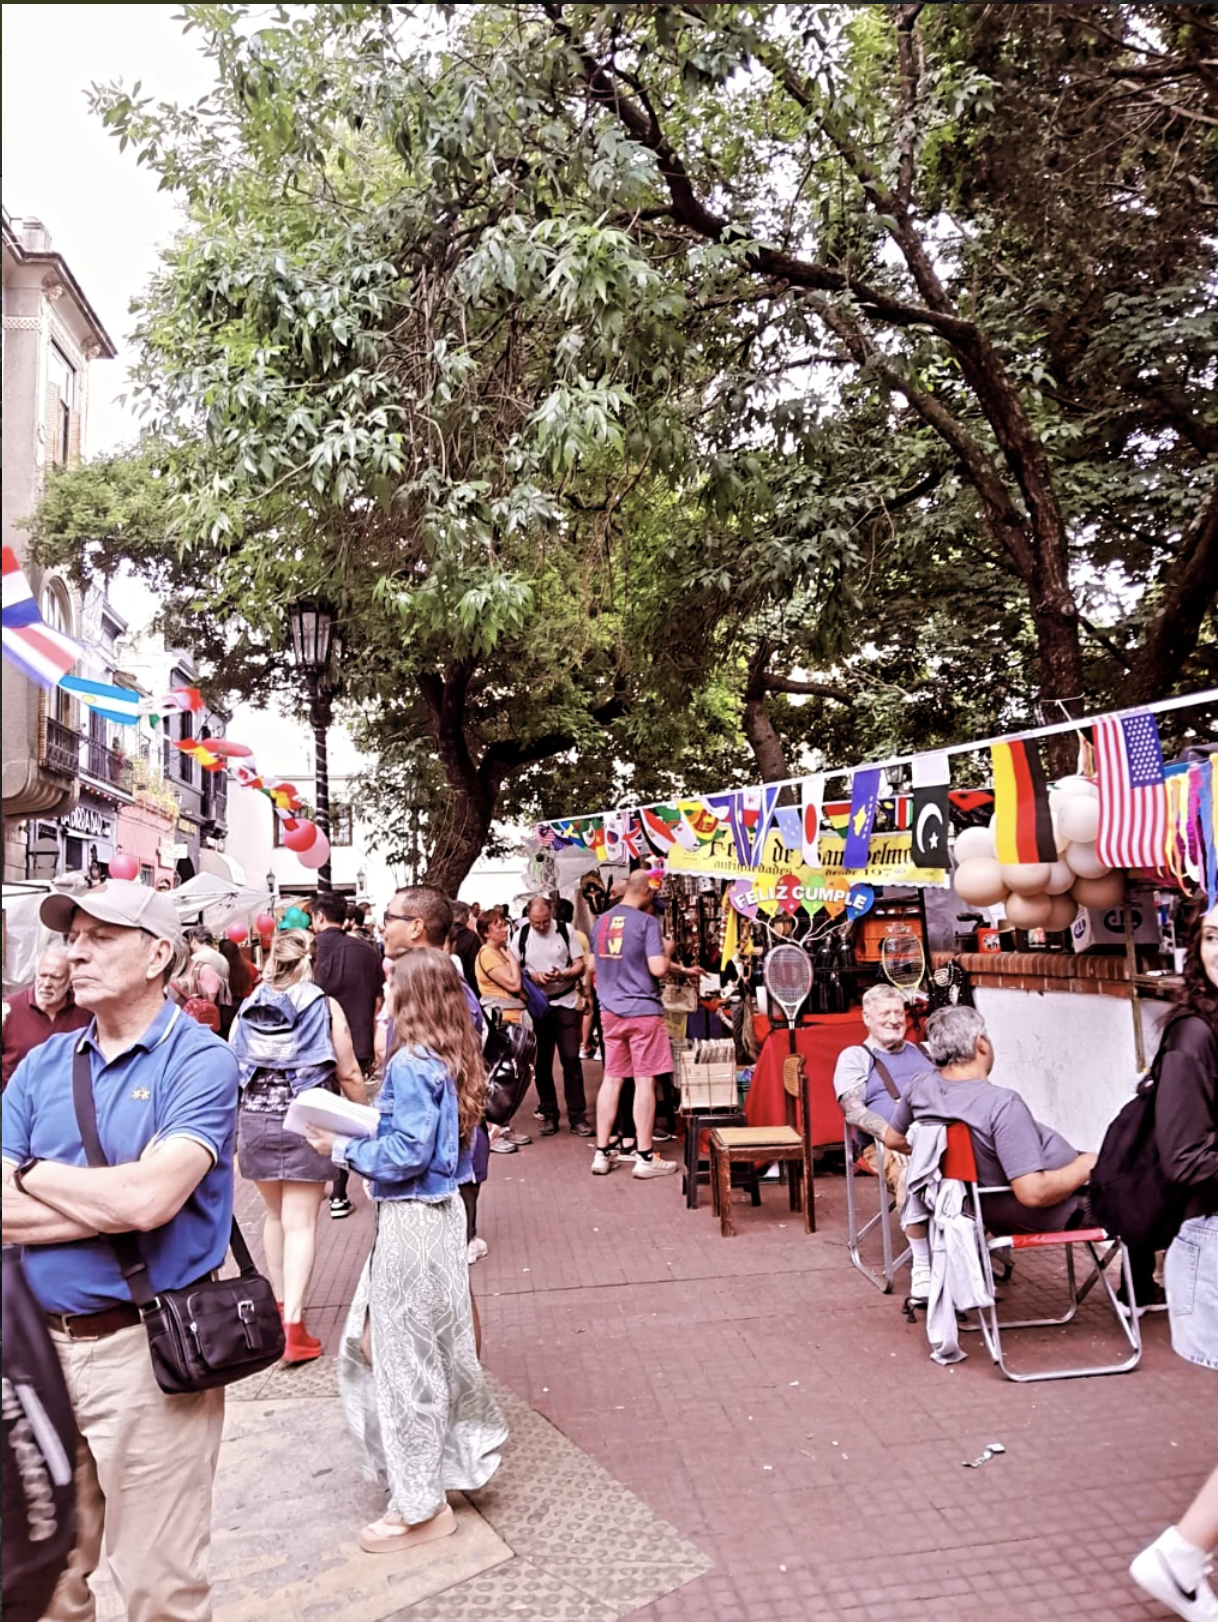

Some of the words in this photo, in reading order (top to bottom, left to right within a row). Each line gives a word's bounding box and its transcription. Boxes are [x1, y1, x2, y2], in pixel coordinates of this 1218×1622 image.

[772, 838, 795, 864] de
[825, 868, 857, 876] desde
[734, 885, 789, 909] FELIZ
[791, 886, 868, 910] CUMPLE
